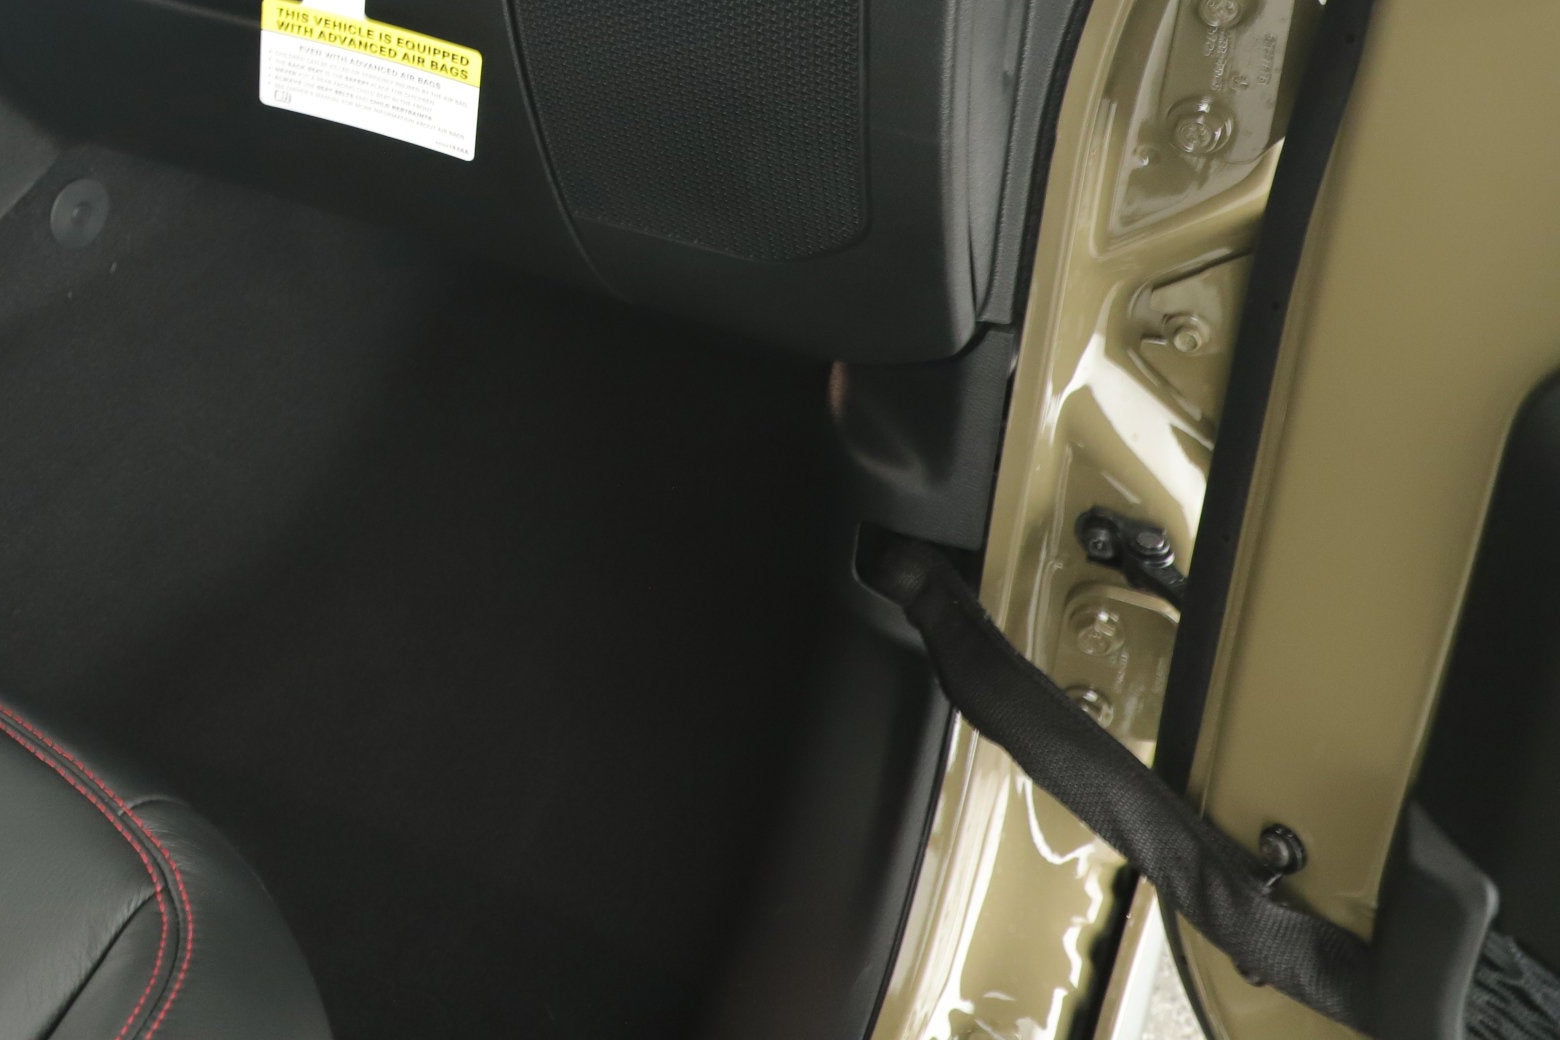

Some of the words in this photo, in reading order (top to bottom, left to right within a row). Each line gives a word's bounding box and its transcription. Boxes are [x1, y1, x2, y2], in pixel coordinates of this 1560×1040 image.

[276, 7, 309, 24] THIS
[313, 15, 374, 39] VEHICLE
[379, 32, 392, 44] IS
[396, 36, 470, 67] EQUIPPED
[276, 20, 313, 37] WITH
[317, 29, 397, 59] ADVANCED
[401, 52, 425, 67] AIR
[430, 59, 469, 81] BAGS
[350, 56, 398, 77] ADVANCED
[400, 70, 415, 81] AIR
[417, 74, 441, 90] BAGS
